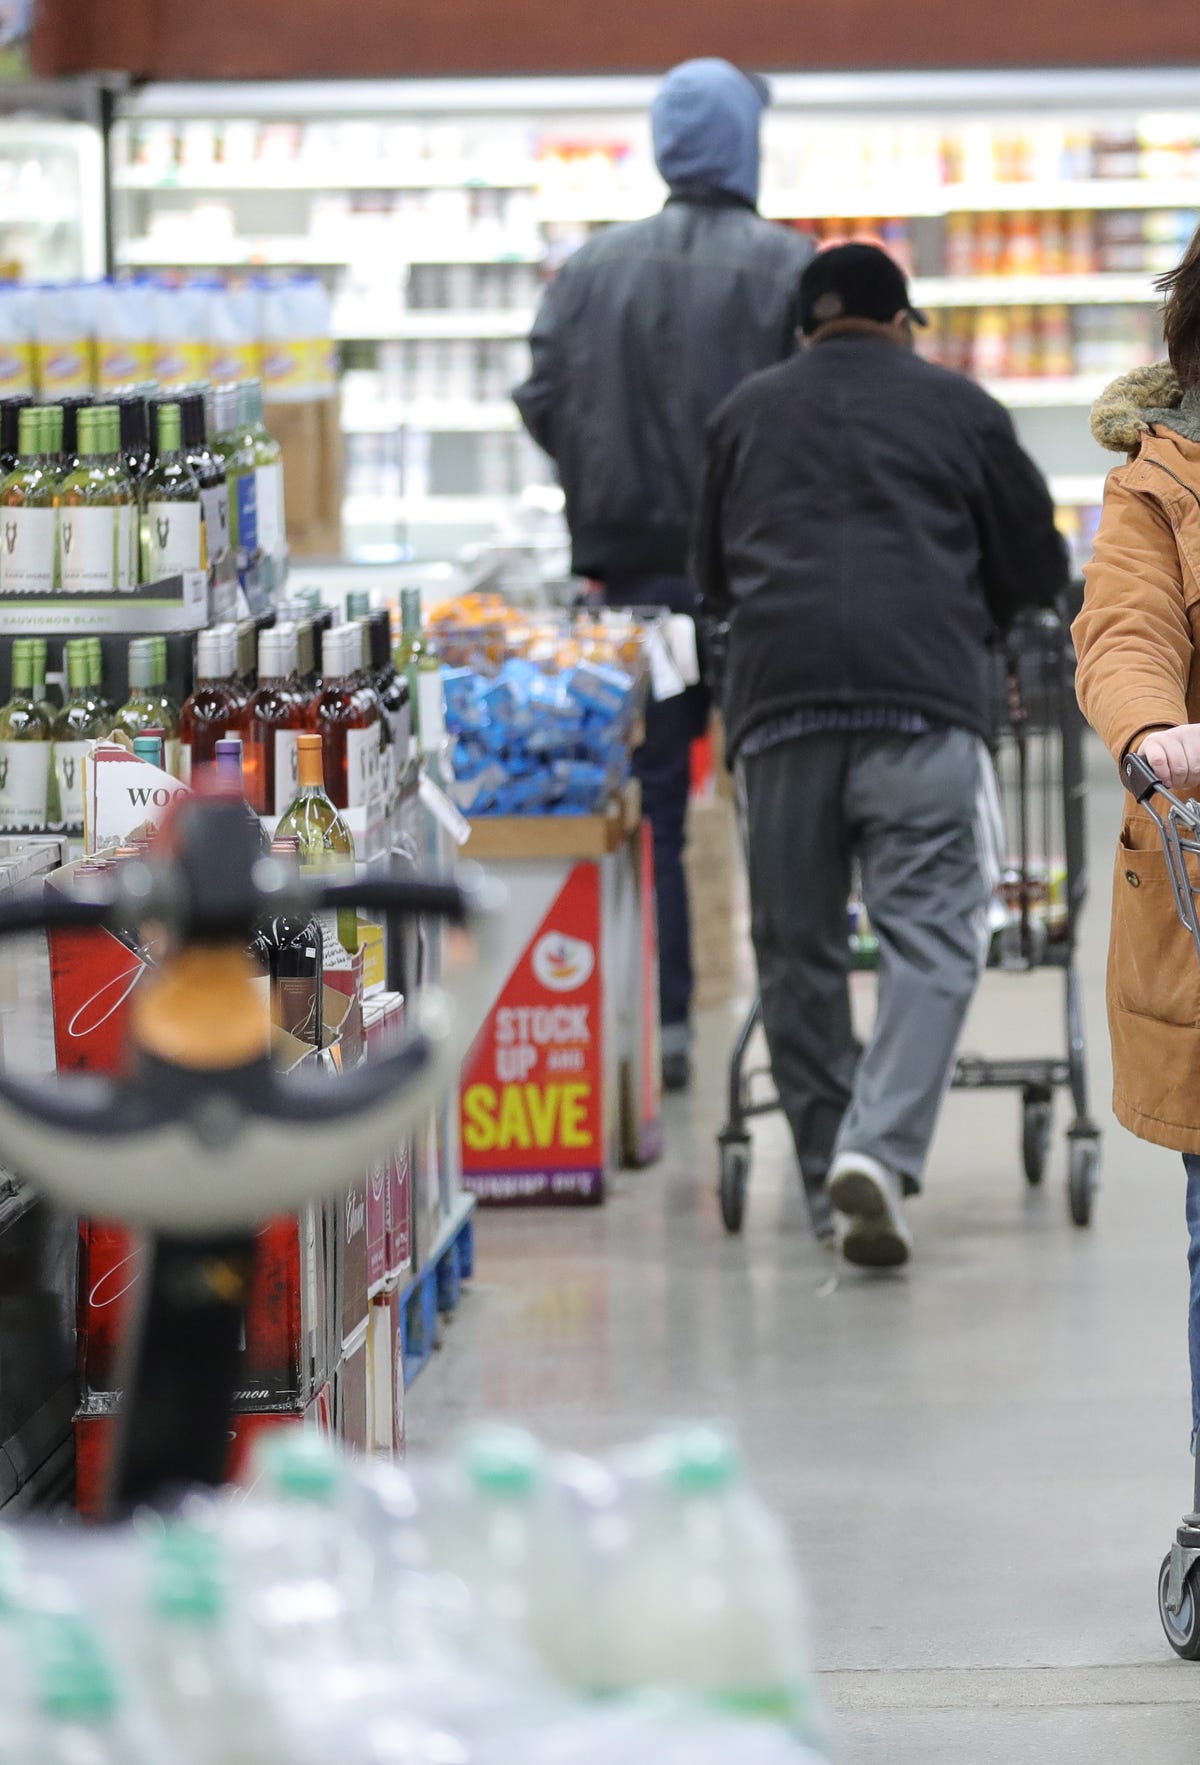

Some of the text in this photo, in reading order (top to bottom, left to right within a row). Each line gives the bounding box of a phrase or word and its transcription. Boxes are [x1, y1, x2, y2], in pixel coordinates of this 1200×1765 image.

[496, 1006, 590, 1044] STOCK
[497, 1045, 538, 1082] UP
[463, 1083, 593, 1150] SAVE
